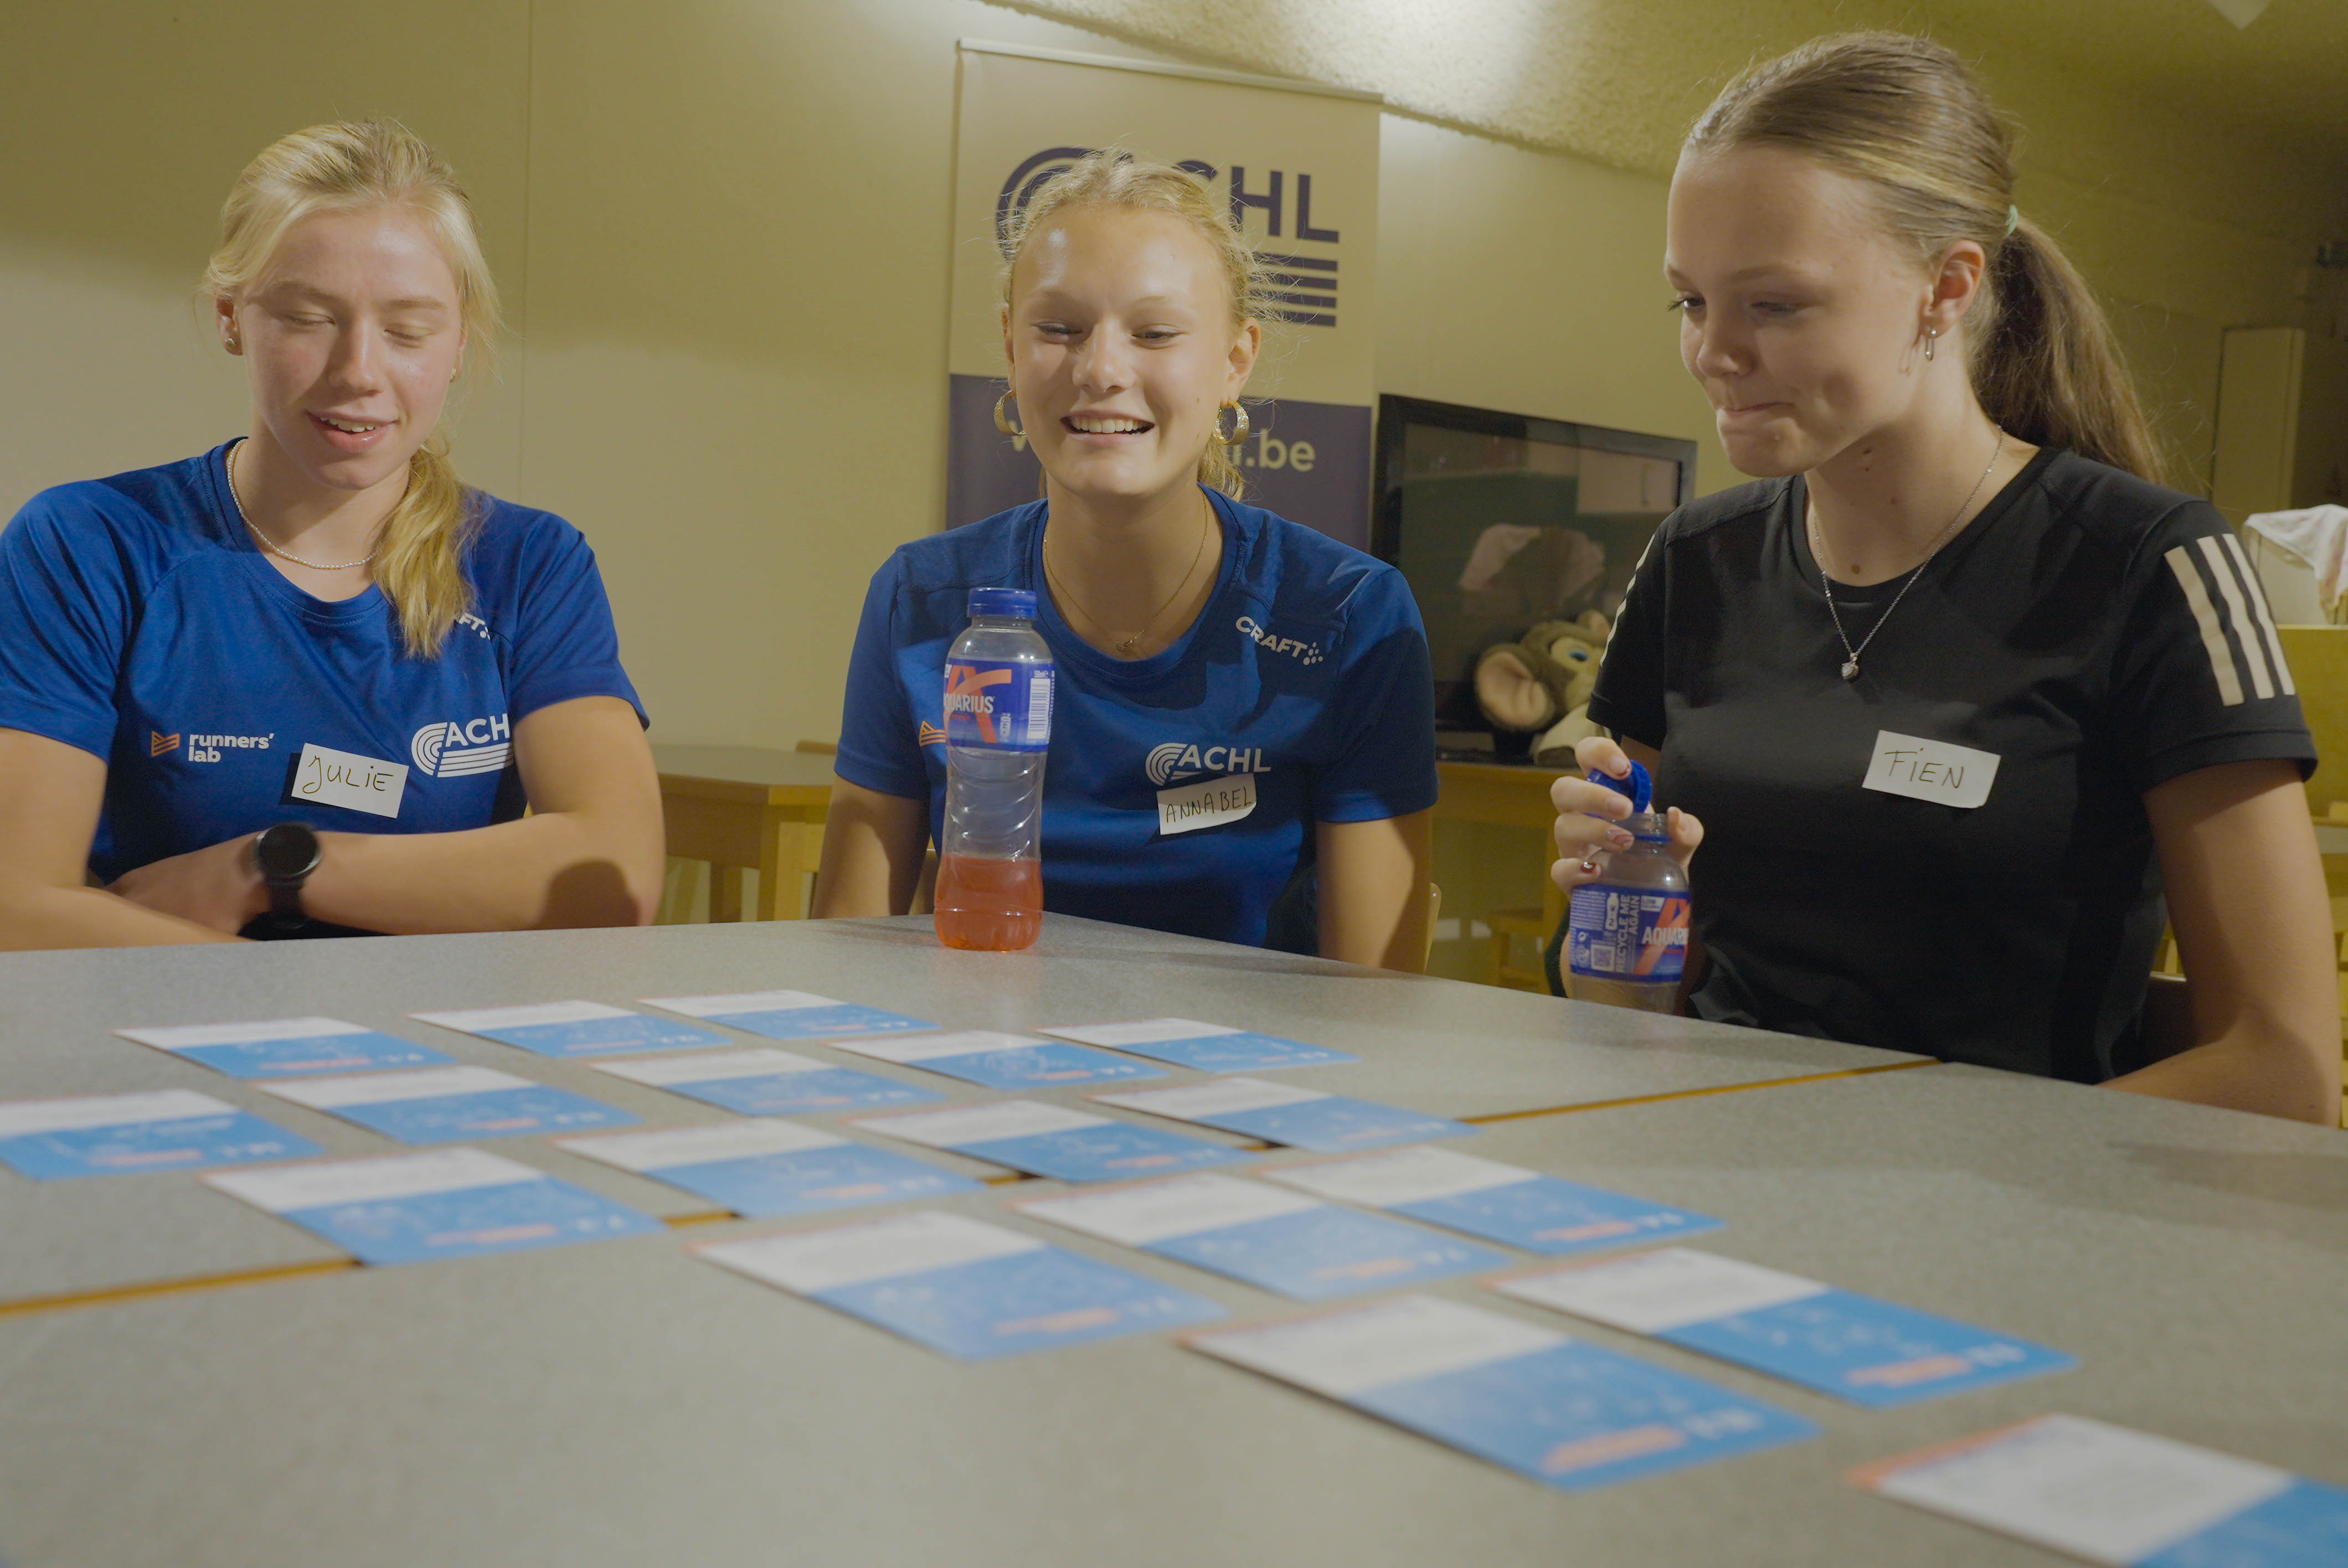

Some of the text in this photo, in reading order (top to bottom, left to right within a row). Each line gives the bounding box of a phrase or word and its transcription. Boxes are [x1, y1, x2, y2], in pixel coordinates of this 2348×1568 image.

[1171, 159, 1339, 244] HL
[1235, 616, 1307, 658] CRAFT
[943, 692, 995, 714] QUARIUS
[445, 713, 510, 747] ACH
[188, 745, 221, 763] lab
[1177, 744, 1271, 773] ACHL
[1166, 787, 1253, 823] ANNABEL
[1629, 895, 1640, 935] AGAIN
[1615, 894, 1631, 973] RECYCLE ME
